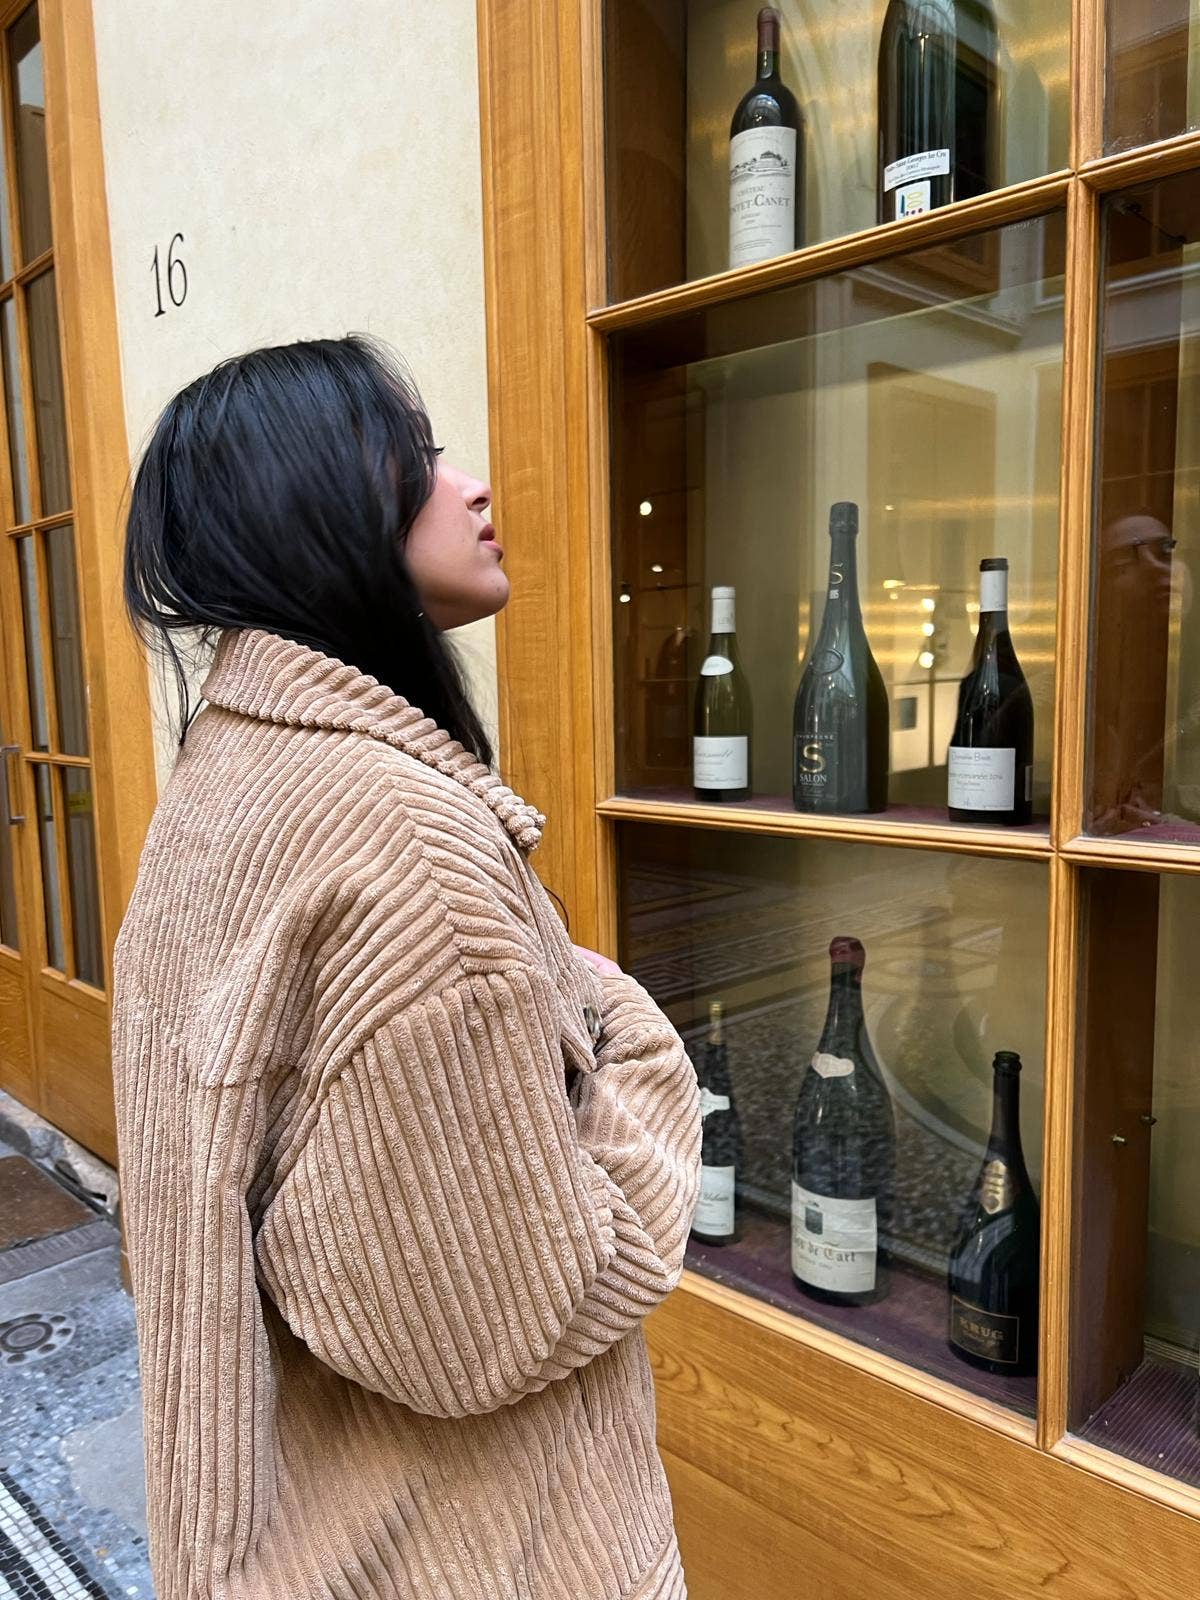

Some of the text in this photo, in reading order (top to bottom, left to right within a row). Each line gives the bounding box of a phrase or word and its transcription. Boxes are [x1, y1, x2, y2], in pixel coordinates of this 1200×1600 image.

[150, 232, 188, 317] 16
[799, 740, 826, 774] S
[799, 773, 827, 783] SALON
